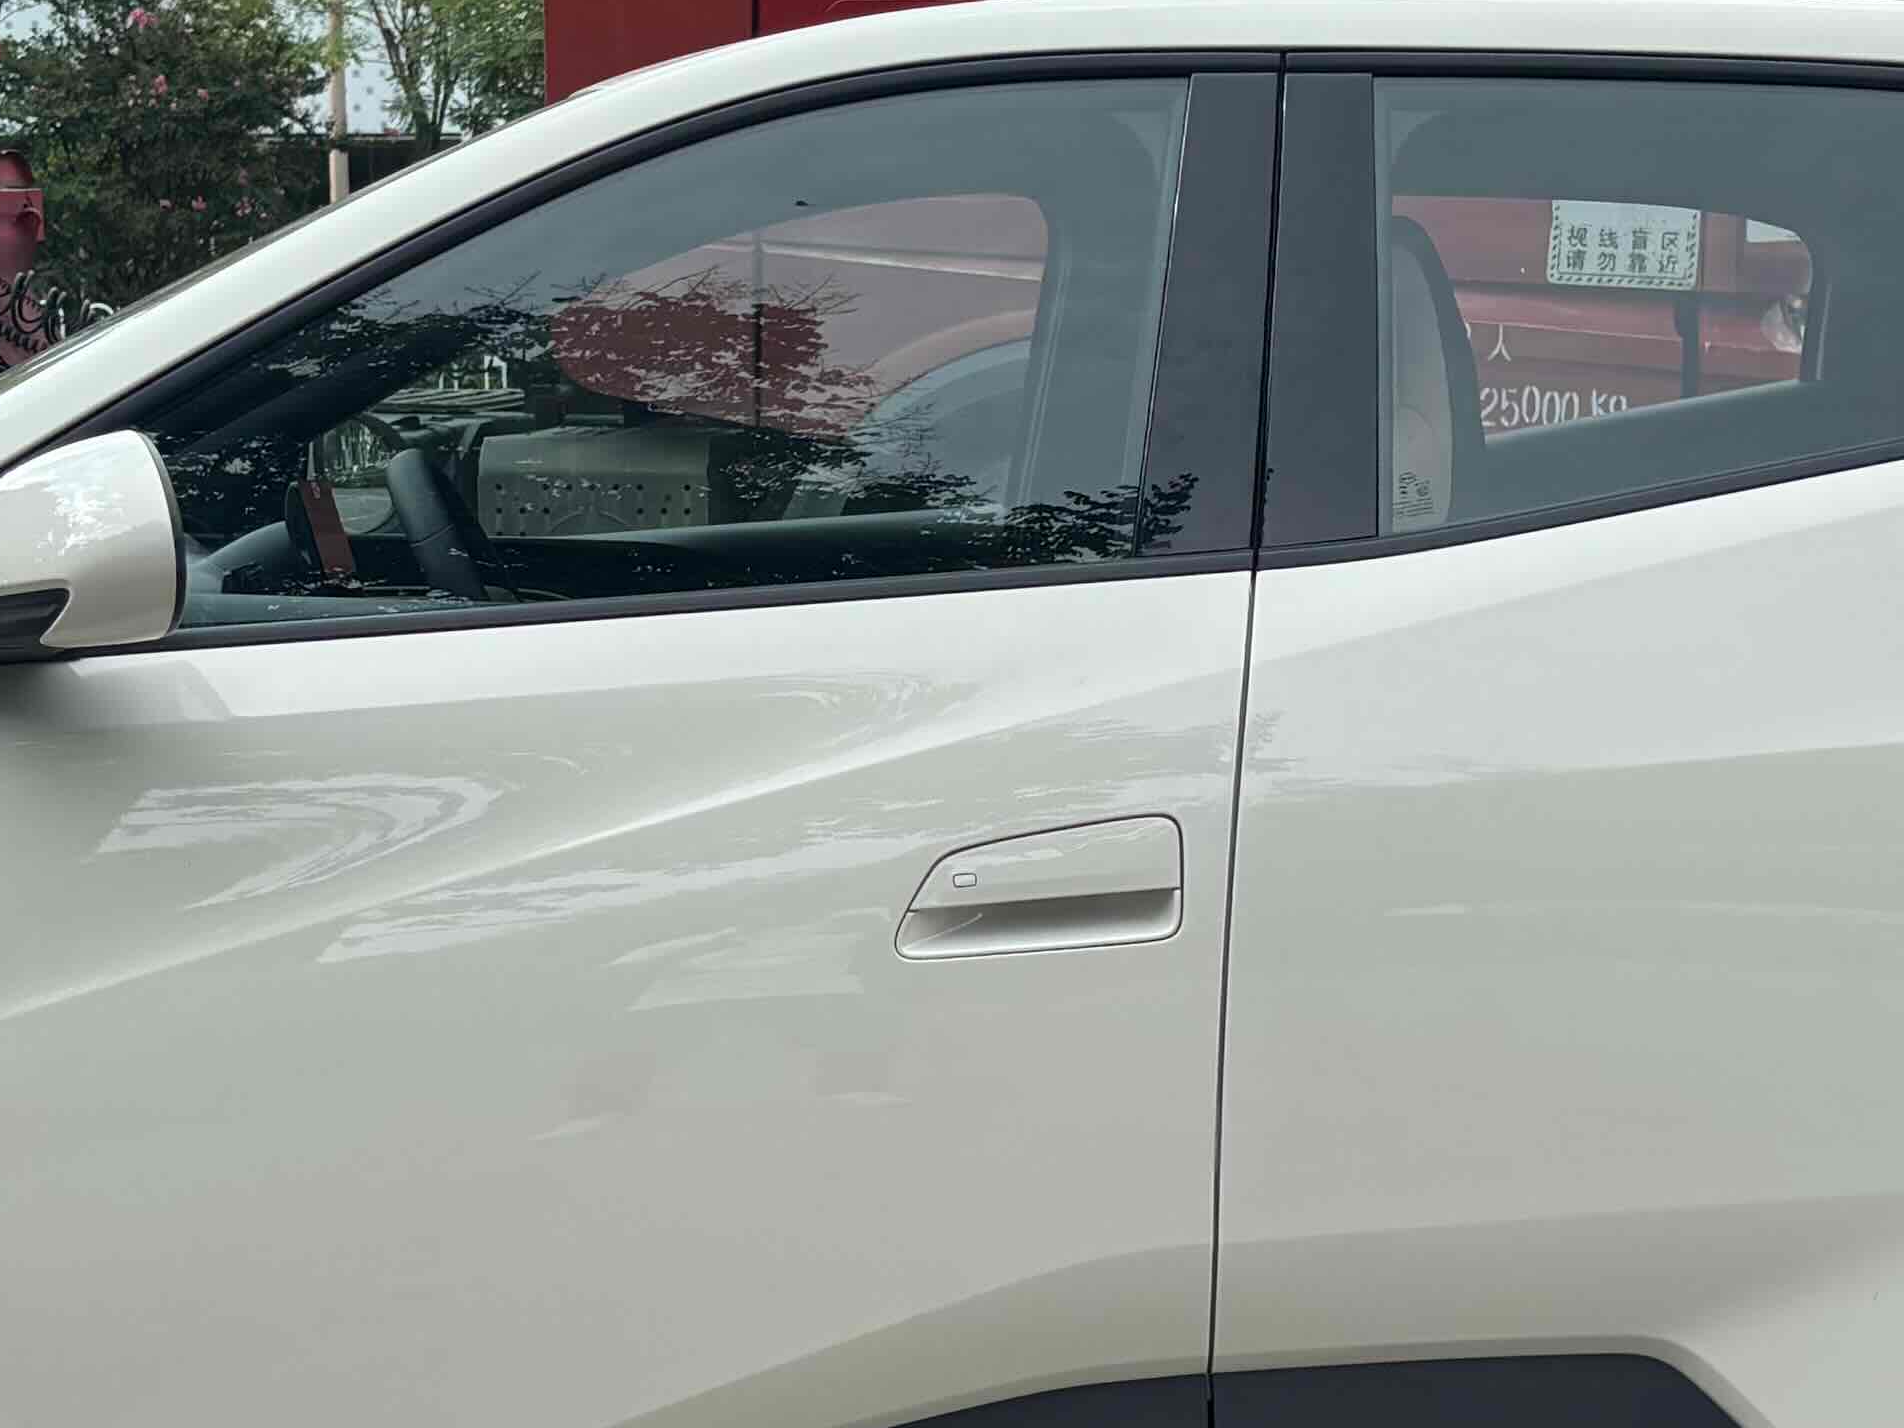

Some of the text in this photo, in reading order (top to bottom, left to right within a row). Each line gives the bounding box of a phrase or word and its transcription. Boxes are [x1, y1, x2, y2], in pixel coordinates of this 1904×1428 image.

[1567, 225, 1680, 252] 视线盲区
[1567, 248, 1679, 274] 请勿靠近
[1480, 385, 1580, 428] 25000
